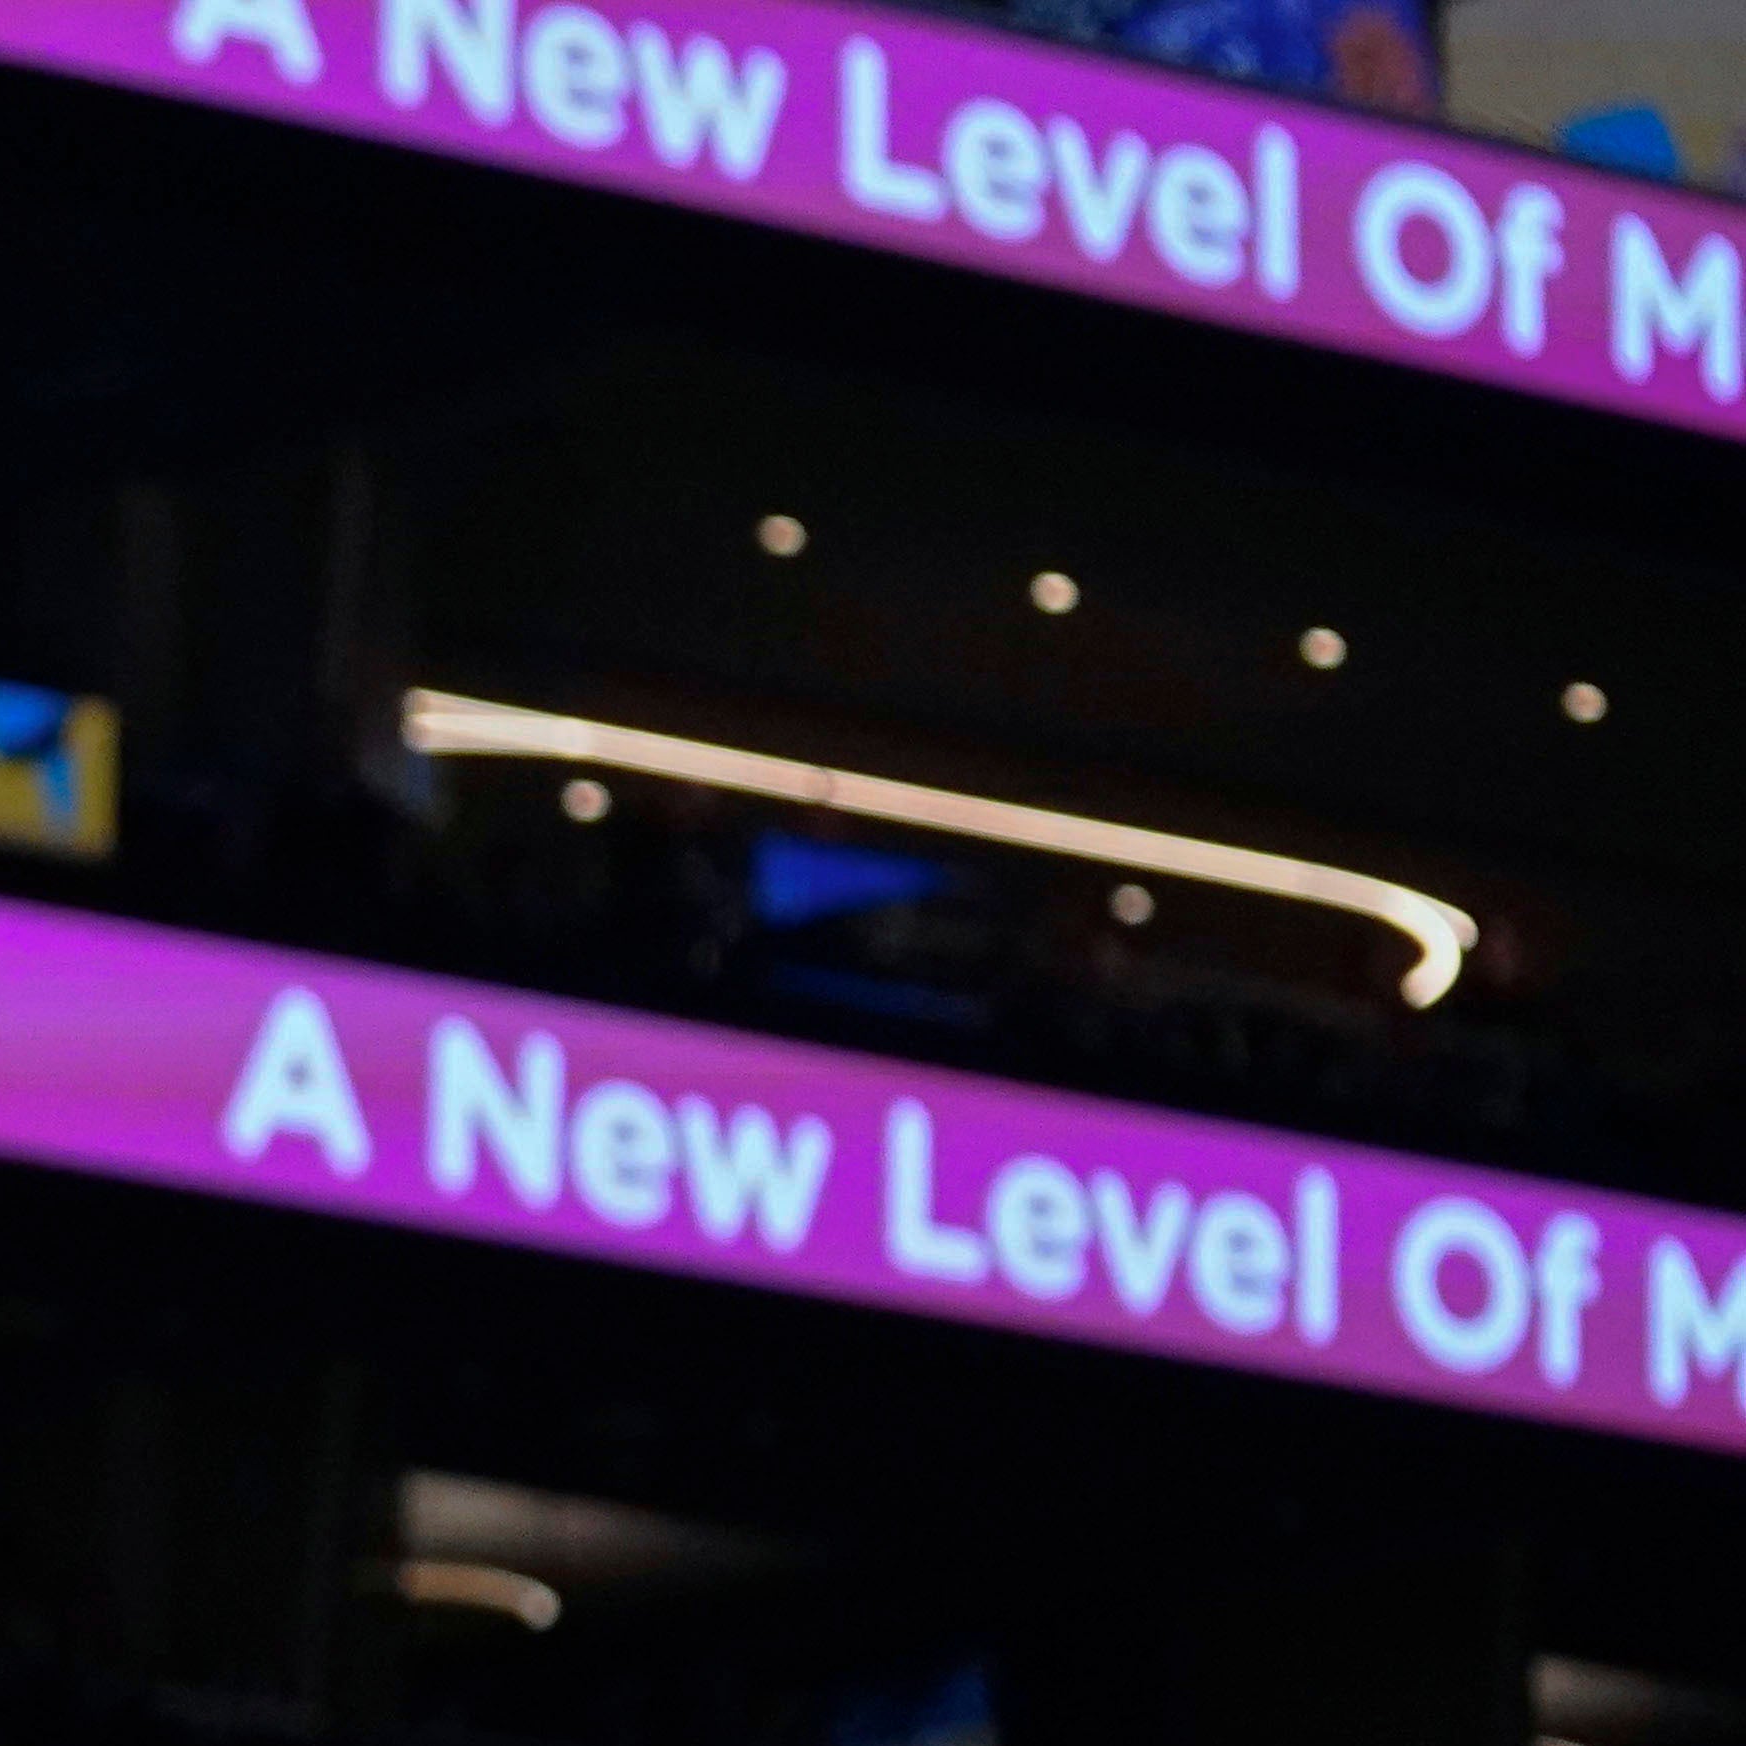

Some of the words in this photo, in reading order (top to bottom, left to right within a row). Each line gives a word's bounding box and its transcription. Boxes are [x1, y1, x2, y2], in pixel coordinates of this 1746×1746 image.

[380, 0, 790, 183] New
[840, 33, 1299, 301] Level
[1357, 160, 1564, 360] Of
[224, 986, 374, 1180] A
[426, 1012, 834, 1253] New
[883, 1096, 1341, 1345] Level
[1393, 1196, 1603, 1390] Of
